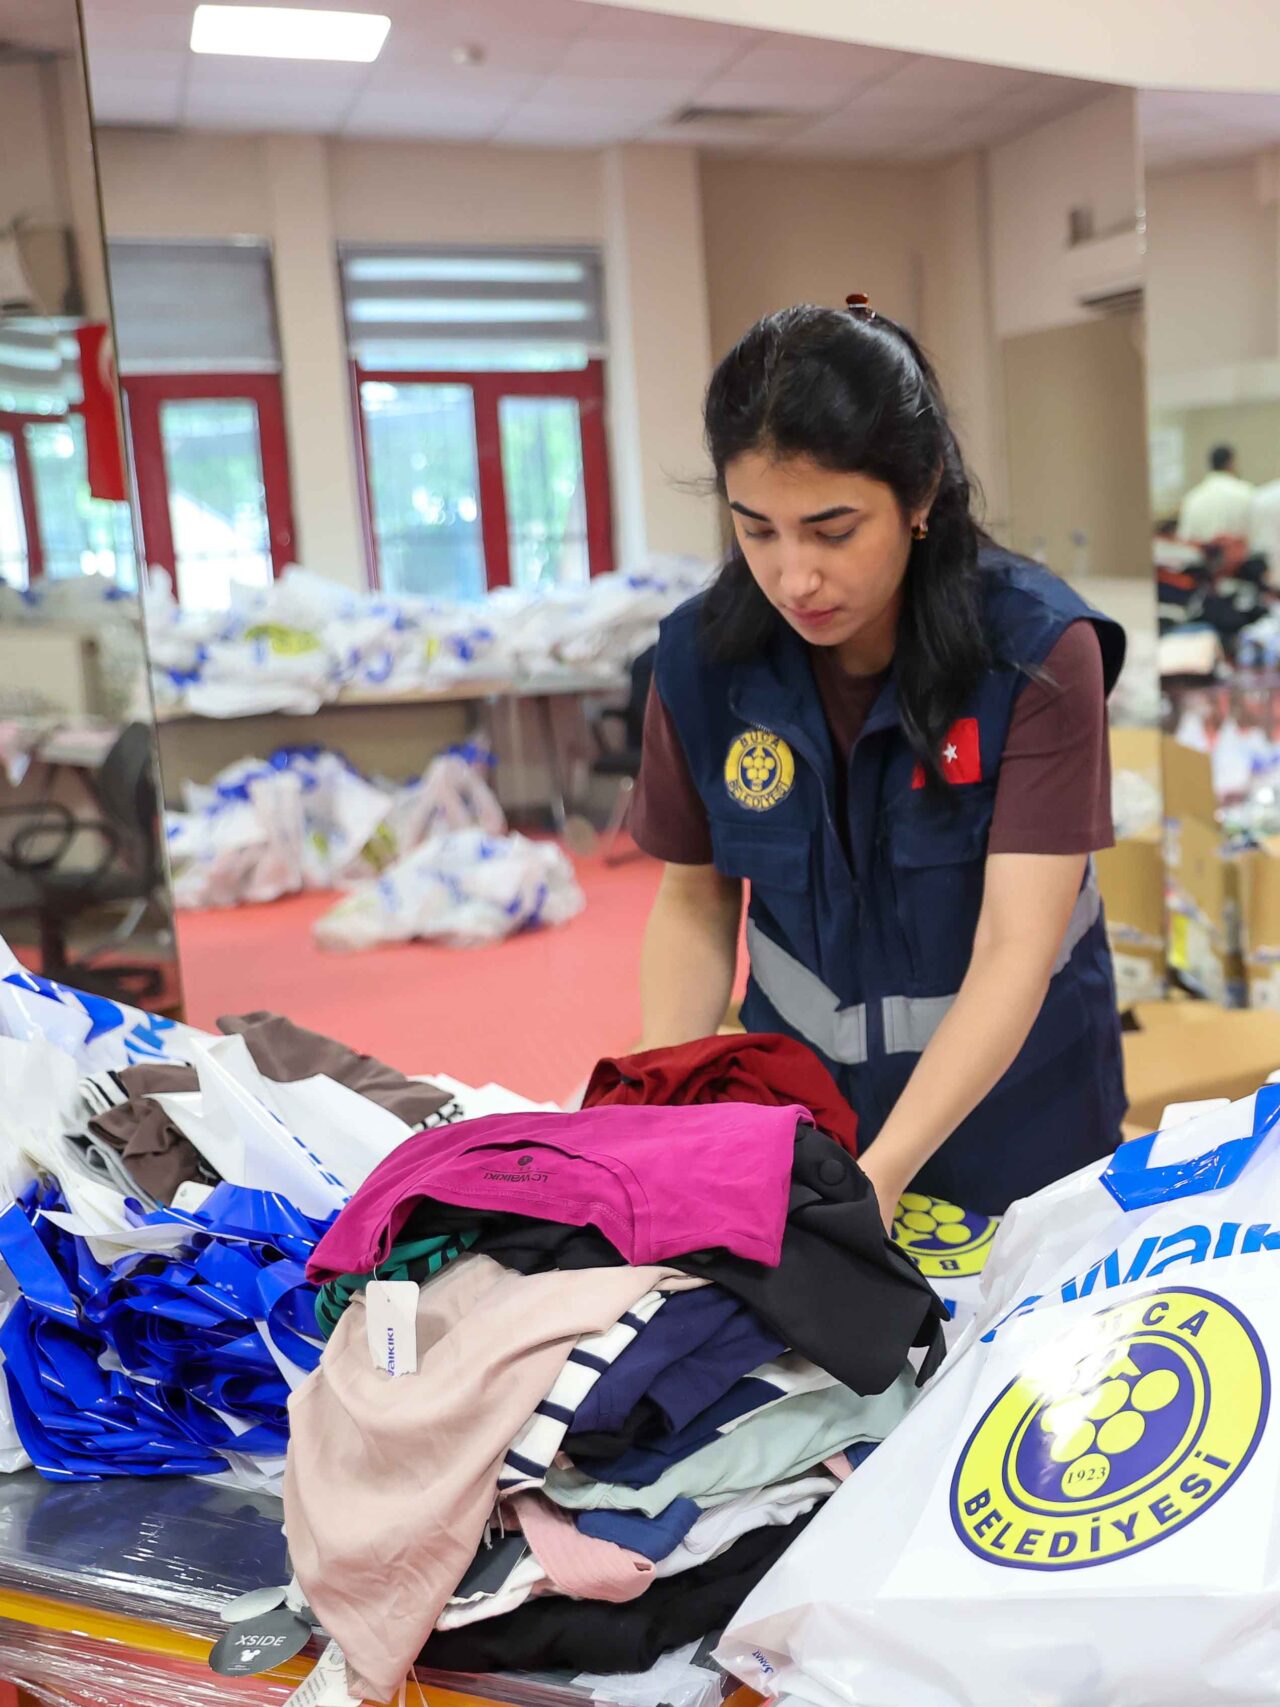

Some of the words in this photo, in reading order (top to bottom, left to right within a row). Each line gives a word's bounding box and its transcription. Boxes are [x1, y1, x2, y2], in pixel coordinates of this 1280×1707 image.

[740, 730, 781, 750] BUCA
[1100, 1301, 1209, 1338] CA
[1067, 1466, 1106, 1484] 1923
[963, 1450, 1232, 1559] BELEDİYESİ
[235, 1634, 288, 1648] XSIDE
